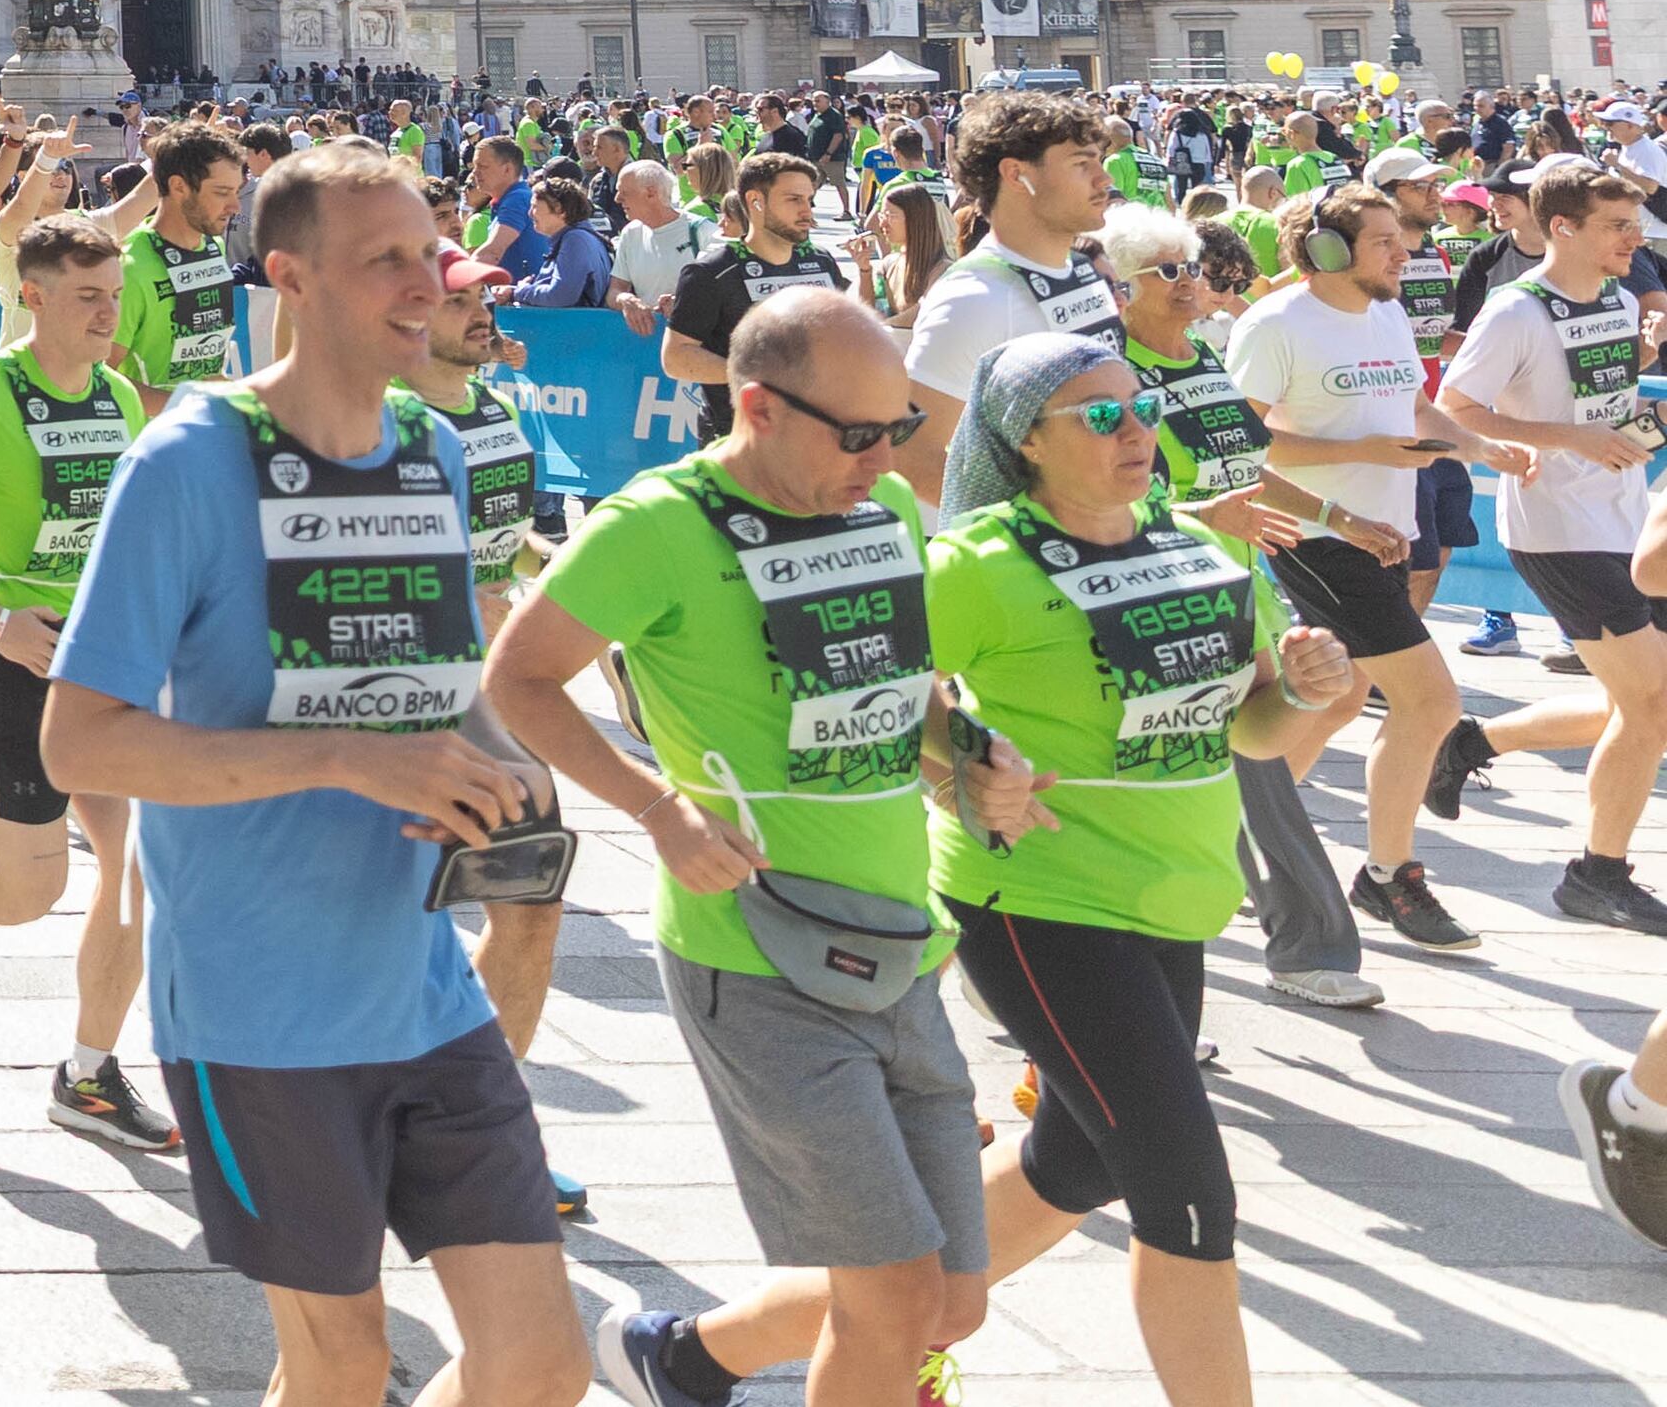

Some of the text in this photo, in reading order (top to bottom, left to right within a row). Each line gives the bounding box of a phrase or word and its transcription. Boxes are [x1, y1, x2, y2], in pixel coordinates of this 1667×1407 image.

[1042, 14, 1098, 26] KIEFER
[1592, 3, 1606, 22] M
[1404, 282, 1447, 295] 36123
[1414, 298, 1442, 307] STRA
[193, 309, 222, 324] STRA
[180, 344, 216, 359] BANCO
[1335, 367, 1414, 389] GIANNAS
[1593, 366, 1627, 383] STRA
[67, 428, 125, 445] HYUNDAI
[475, 432, 520, 453] HYUNDAI
[55, 459, 119, 484] 3642
[397, 461, 440, 480] HOKA
[472, 460, 530, 494] 28038
[483, 493, 517, 516] STRA
[337, 513, 447, 537] HYUNDAI
[803, 541, 904, 574] HYUNDAI
[720, 569, 747, 582] BAN
[1121, 557, 1222, 586] HYUNDAI
[296, 564, 442, 604] 42276
[802, 589, 894, 634] 7843
[1121, 589, 1237, 639] 13594
[329, 612, 416, 641] STRA
[823, 633, 890, 668] STRA
[1153, 631, 1229, 668] STRA
[295, 689, 457, 718] BANCO BPM
[814, 708, 895, 742] BANCO
[1140, 704, 1227, 732] BANCO
